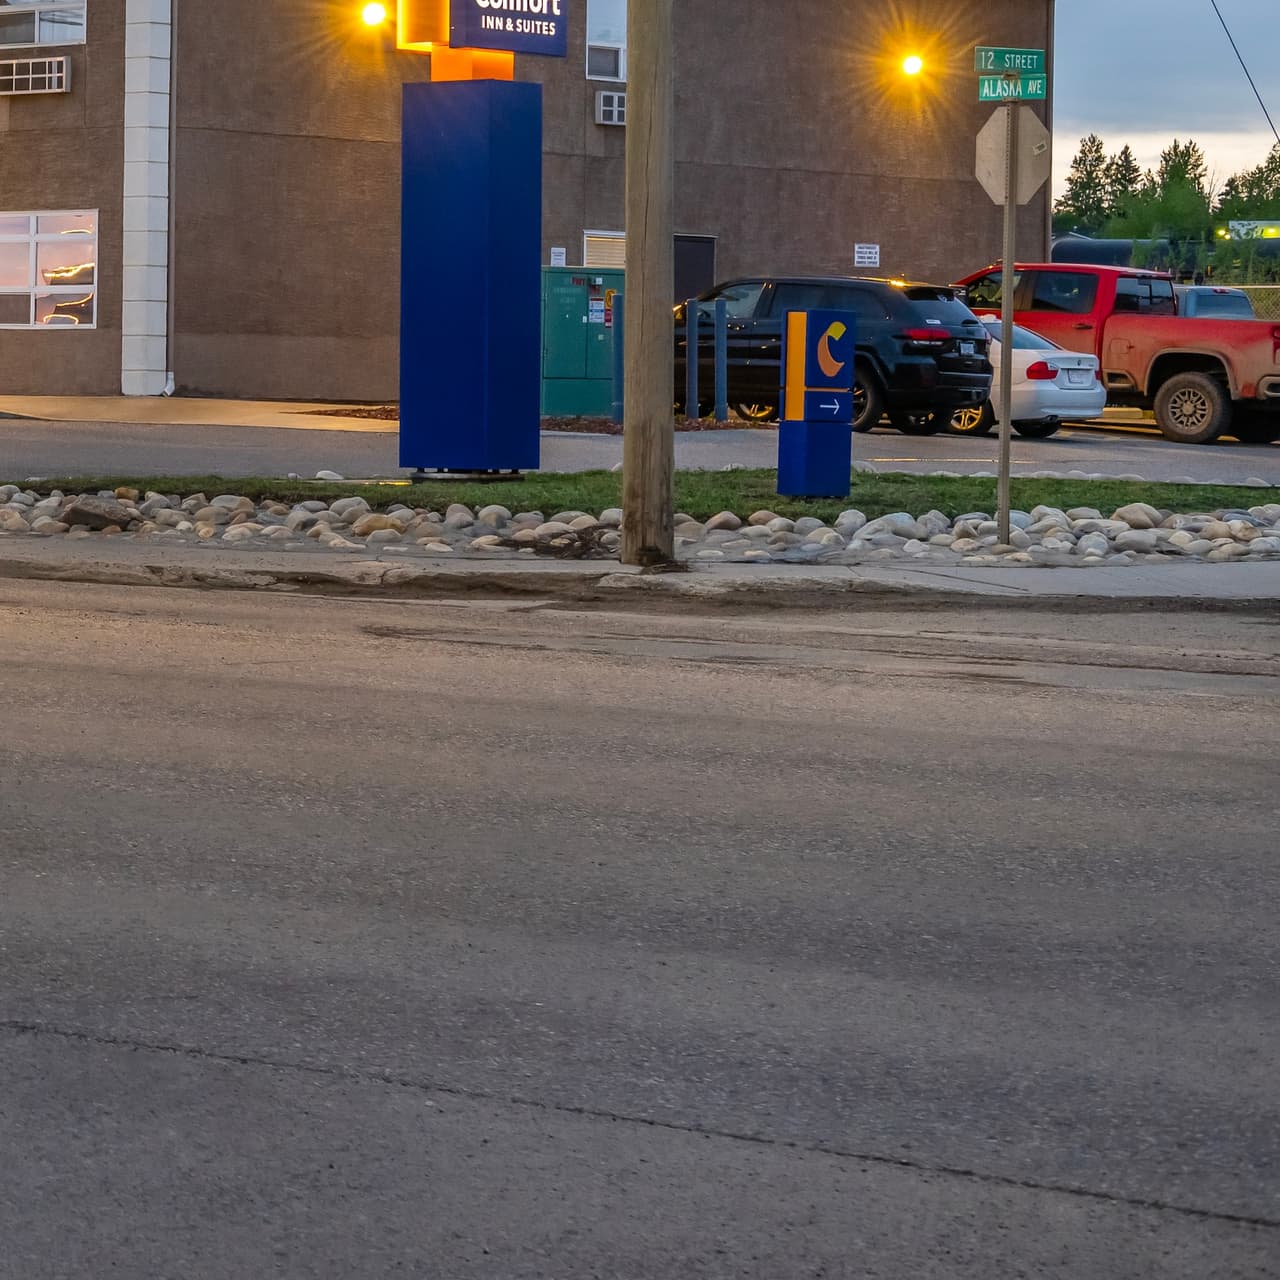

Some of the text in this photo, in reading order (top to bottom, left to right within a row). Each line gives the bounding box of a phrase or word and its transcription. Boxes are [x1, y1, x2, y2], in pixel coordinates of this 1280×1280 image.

[481, 15, 556, 36] INN & SUITES
[981, 51, 1038, 69] 12 STREET
[982, 79, 1042, 97] ALASKA AVE
